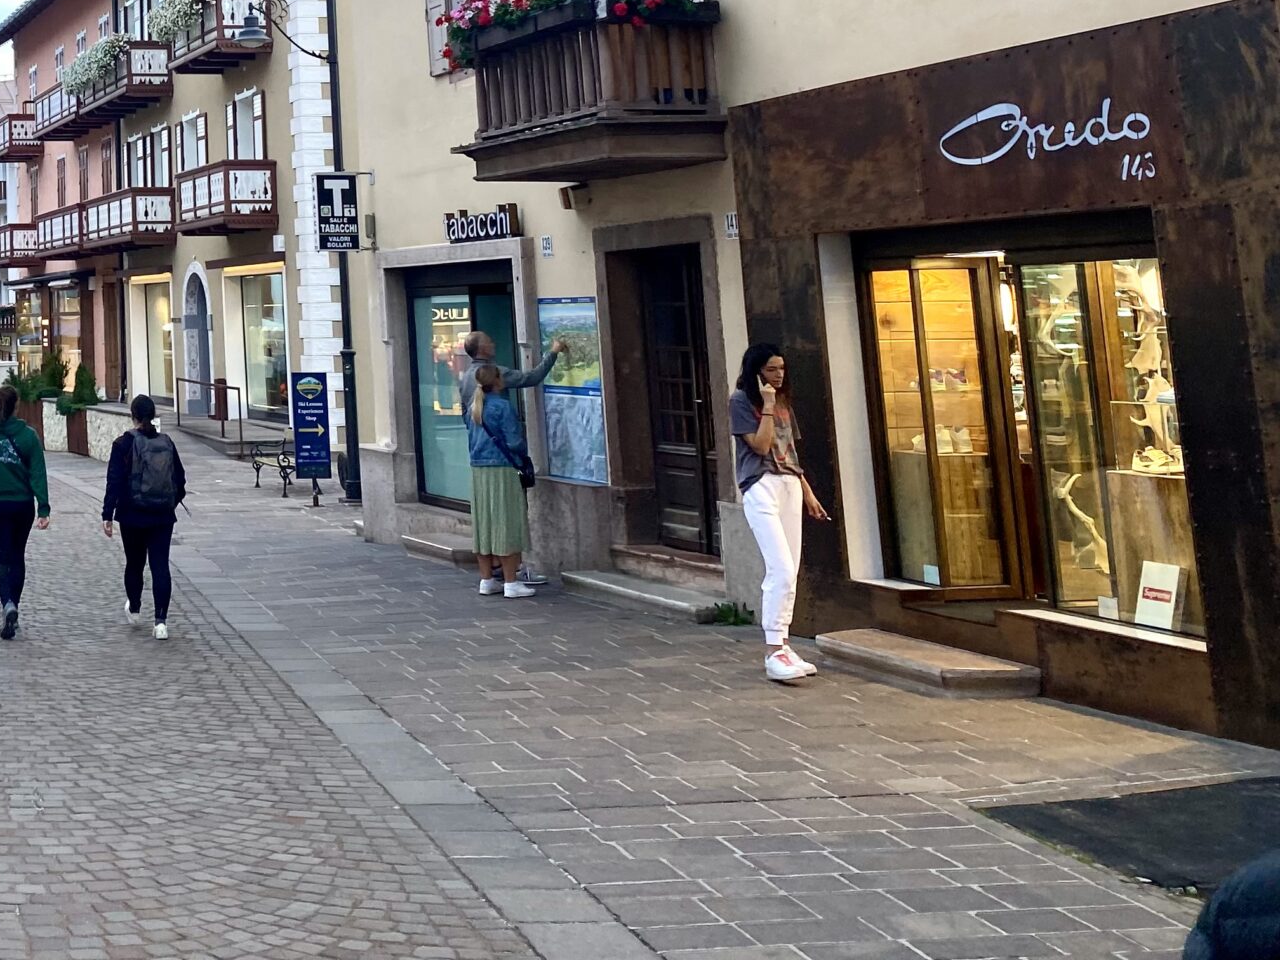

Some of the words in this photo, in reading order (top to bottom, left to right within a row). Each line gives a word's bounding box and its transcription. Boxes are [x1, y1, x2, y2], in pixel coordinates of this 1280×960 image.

[1121, 151, 1156, 181] 143
[323, 179, 350, 217] T
[320, 224, 358, 233] TABACCHI
[443, 203, 511, 240] tabacchi
